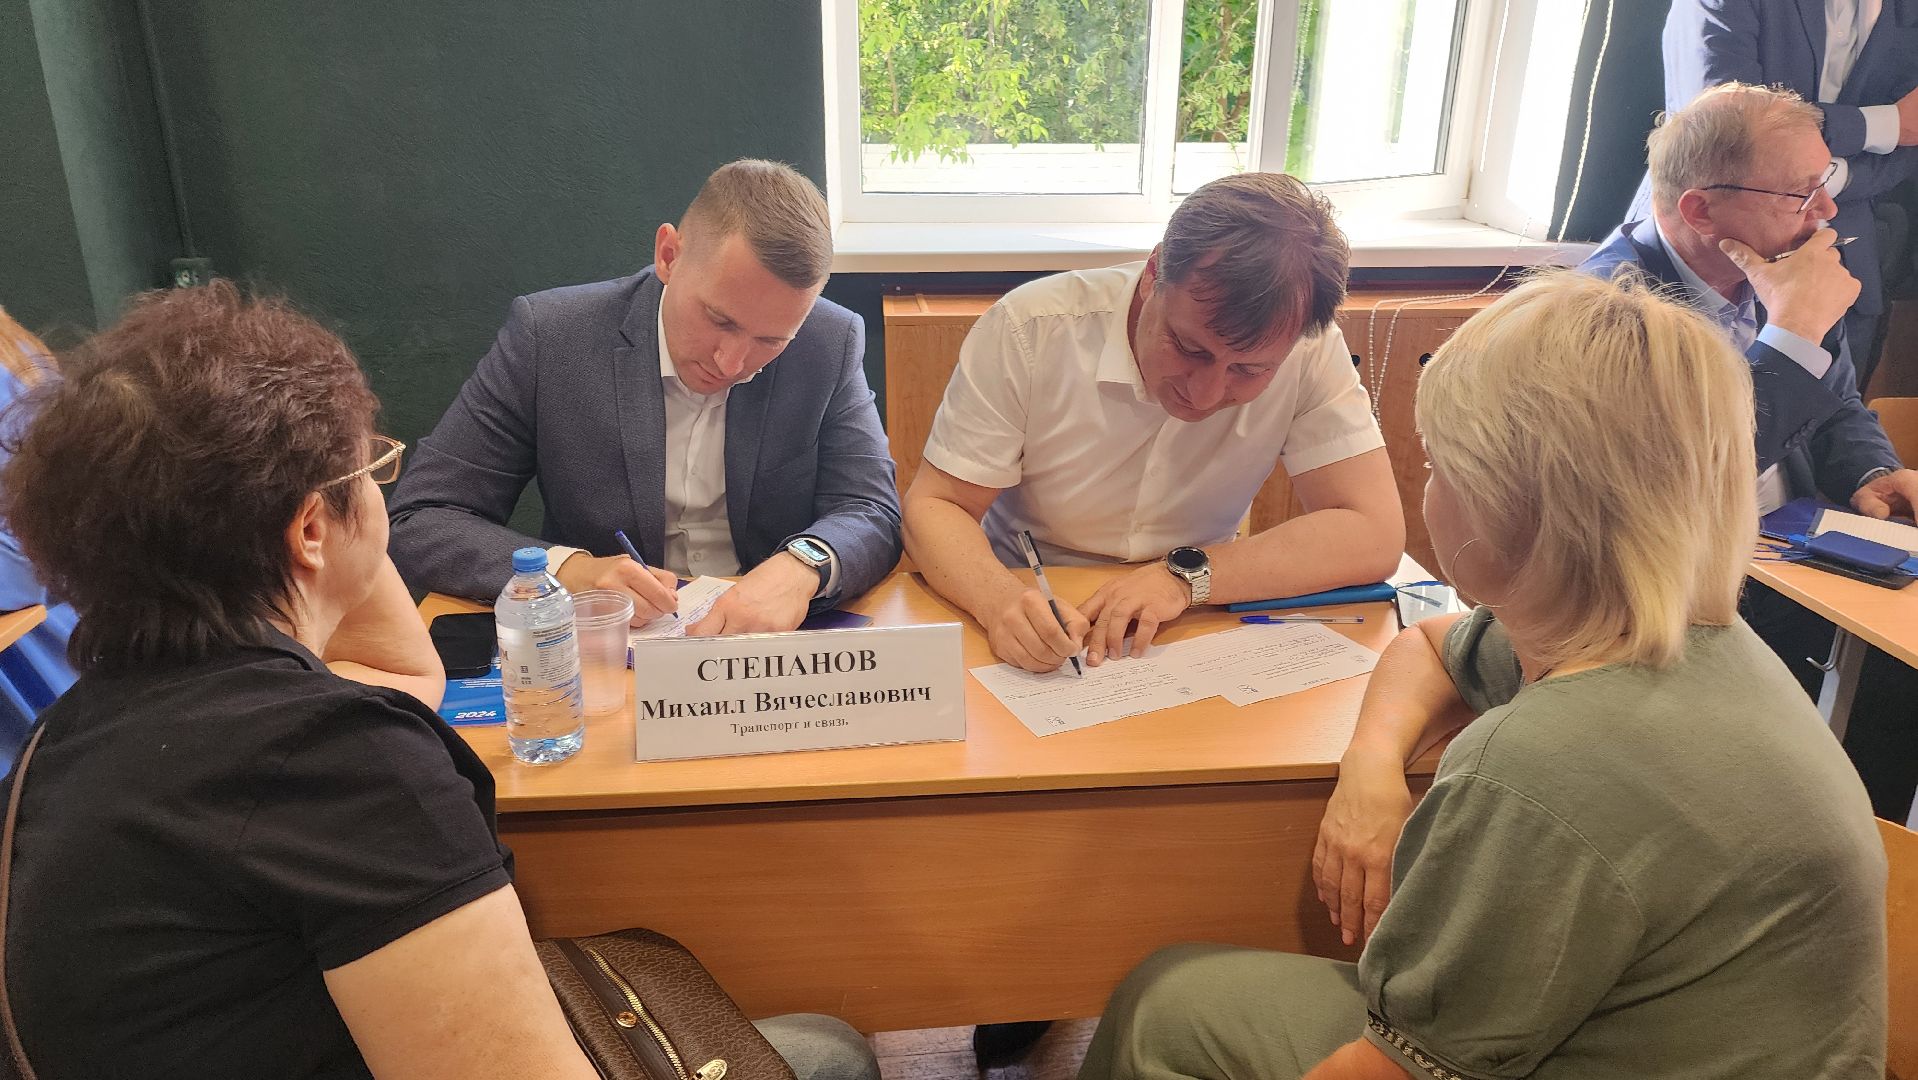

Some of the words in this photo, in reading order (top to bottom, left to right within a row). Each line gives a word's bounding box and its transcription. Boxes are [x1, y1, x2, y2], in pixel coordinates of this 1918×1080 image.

[697, 649, 878, 682] СТЕПАНОВ
[454, 710, 497, 719] 2024
[640, 698, 746, 721] Михаил
[754, 686, 932, 714] Вячеславович
[731, 722, 799, 736] Транспорт
[803, 721, 811, 729] и
[815, 718, 850, 727] связь
